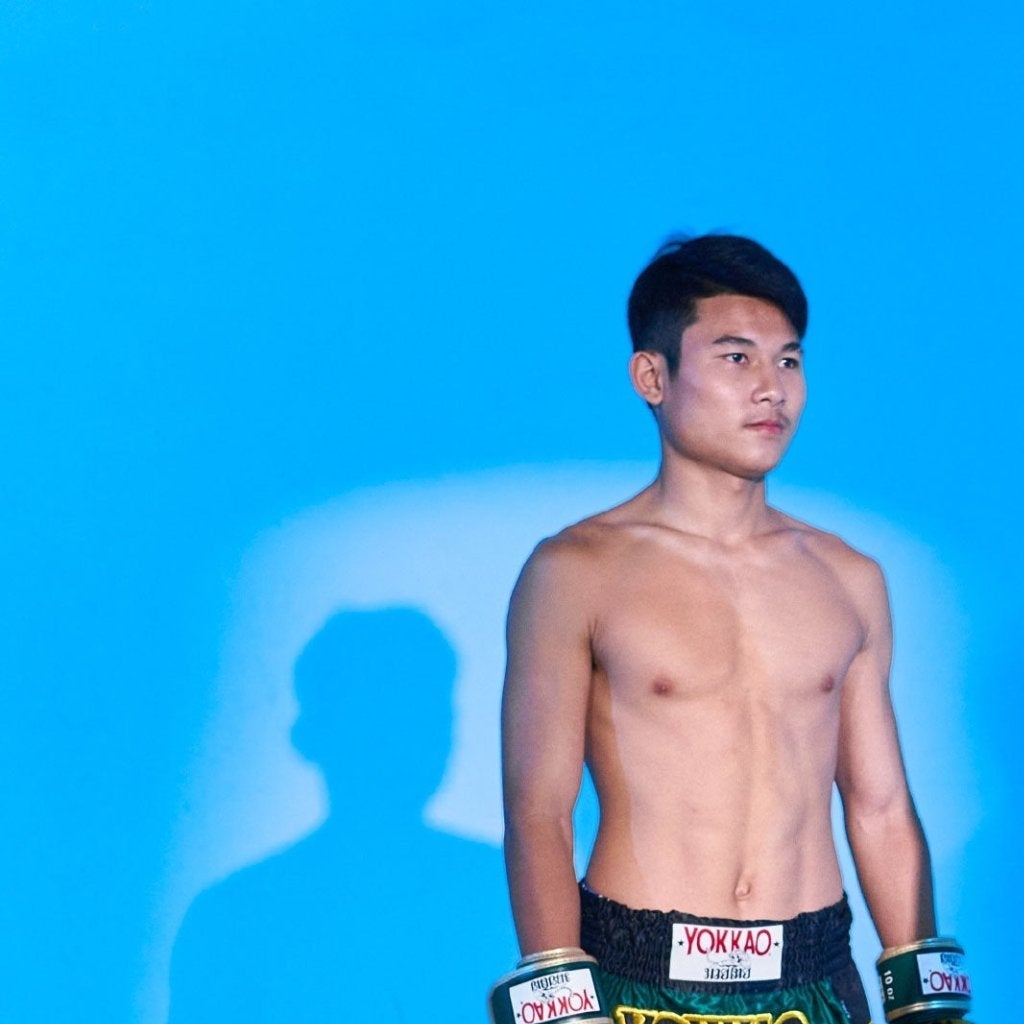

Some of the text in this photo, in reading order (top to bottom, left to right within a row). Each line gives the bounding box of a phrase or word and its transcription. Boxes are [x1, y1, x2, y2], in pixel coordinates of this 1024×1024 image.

[684, 926, 772, 956] YOKKAO
[883, 969, 894, 985] 10
[522, 990, 594, 1024] YOKKAO
